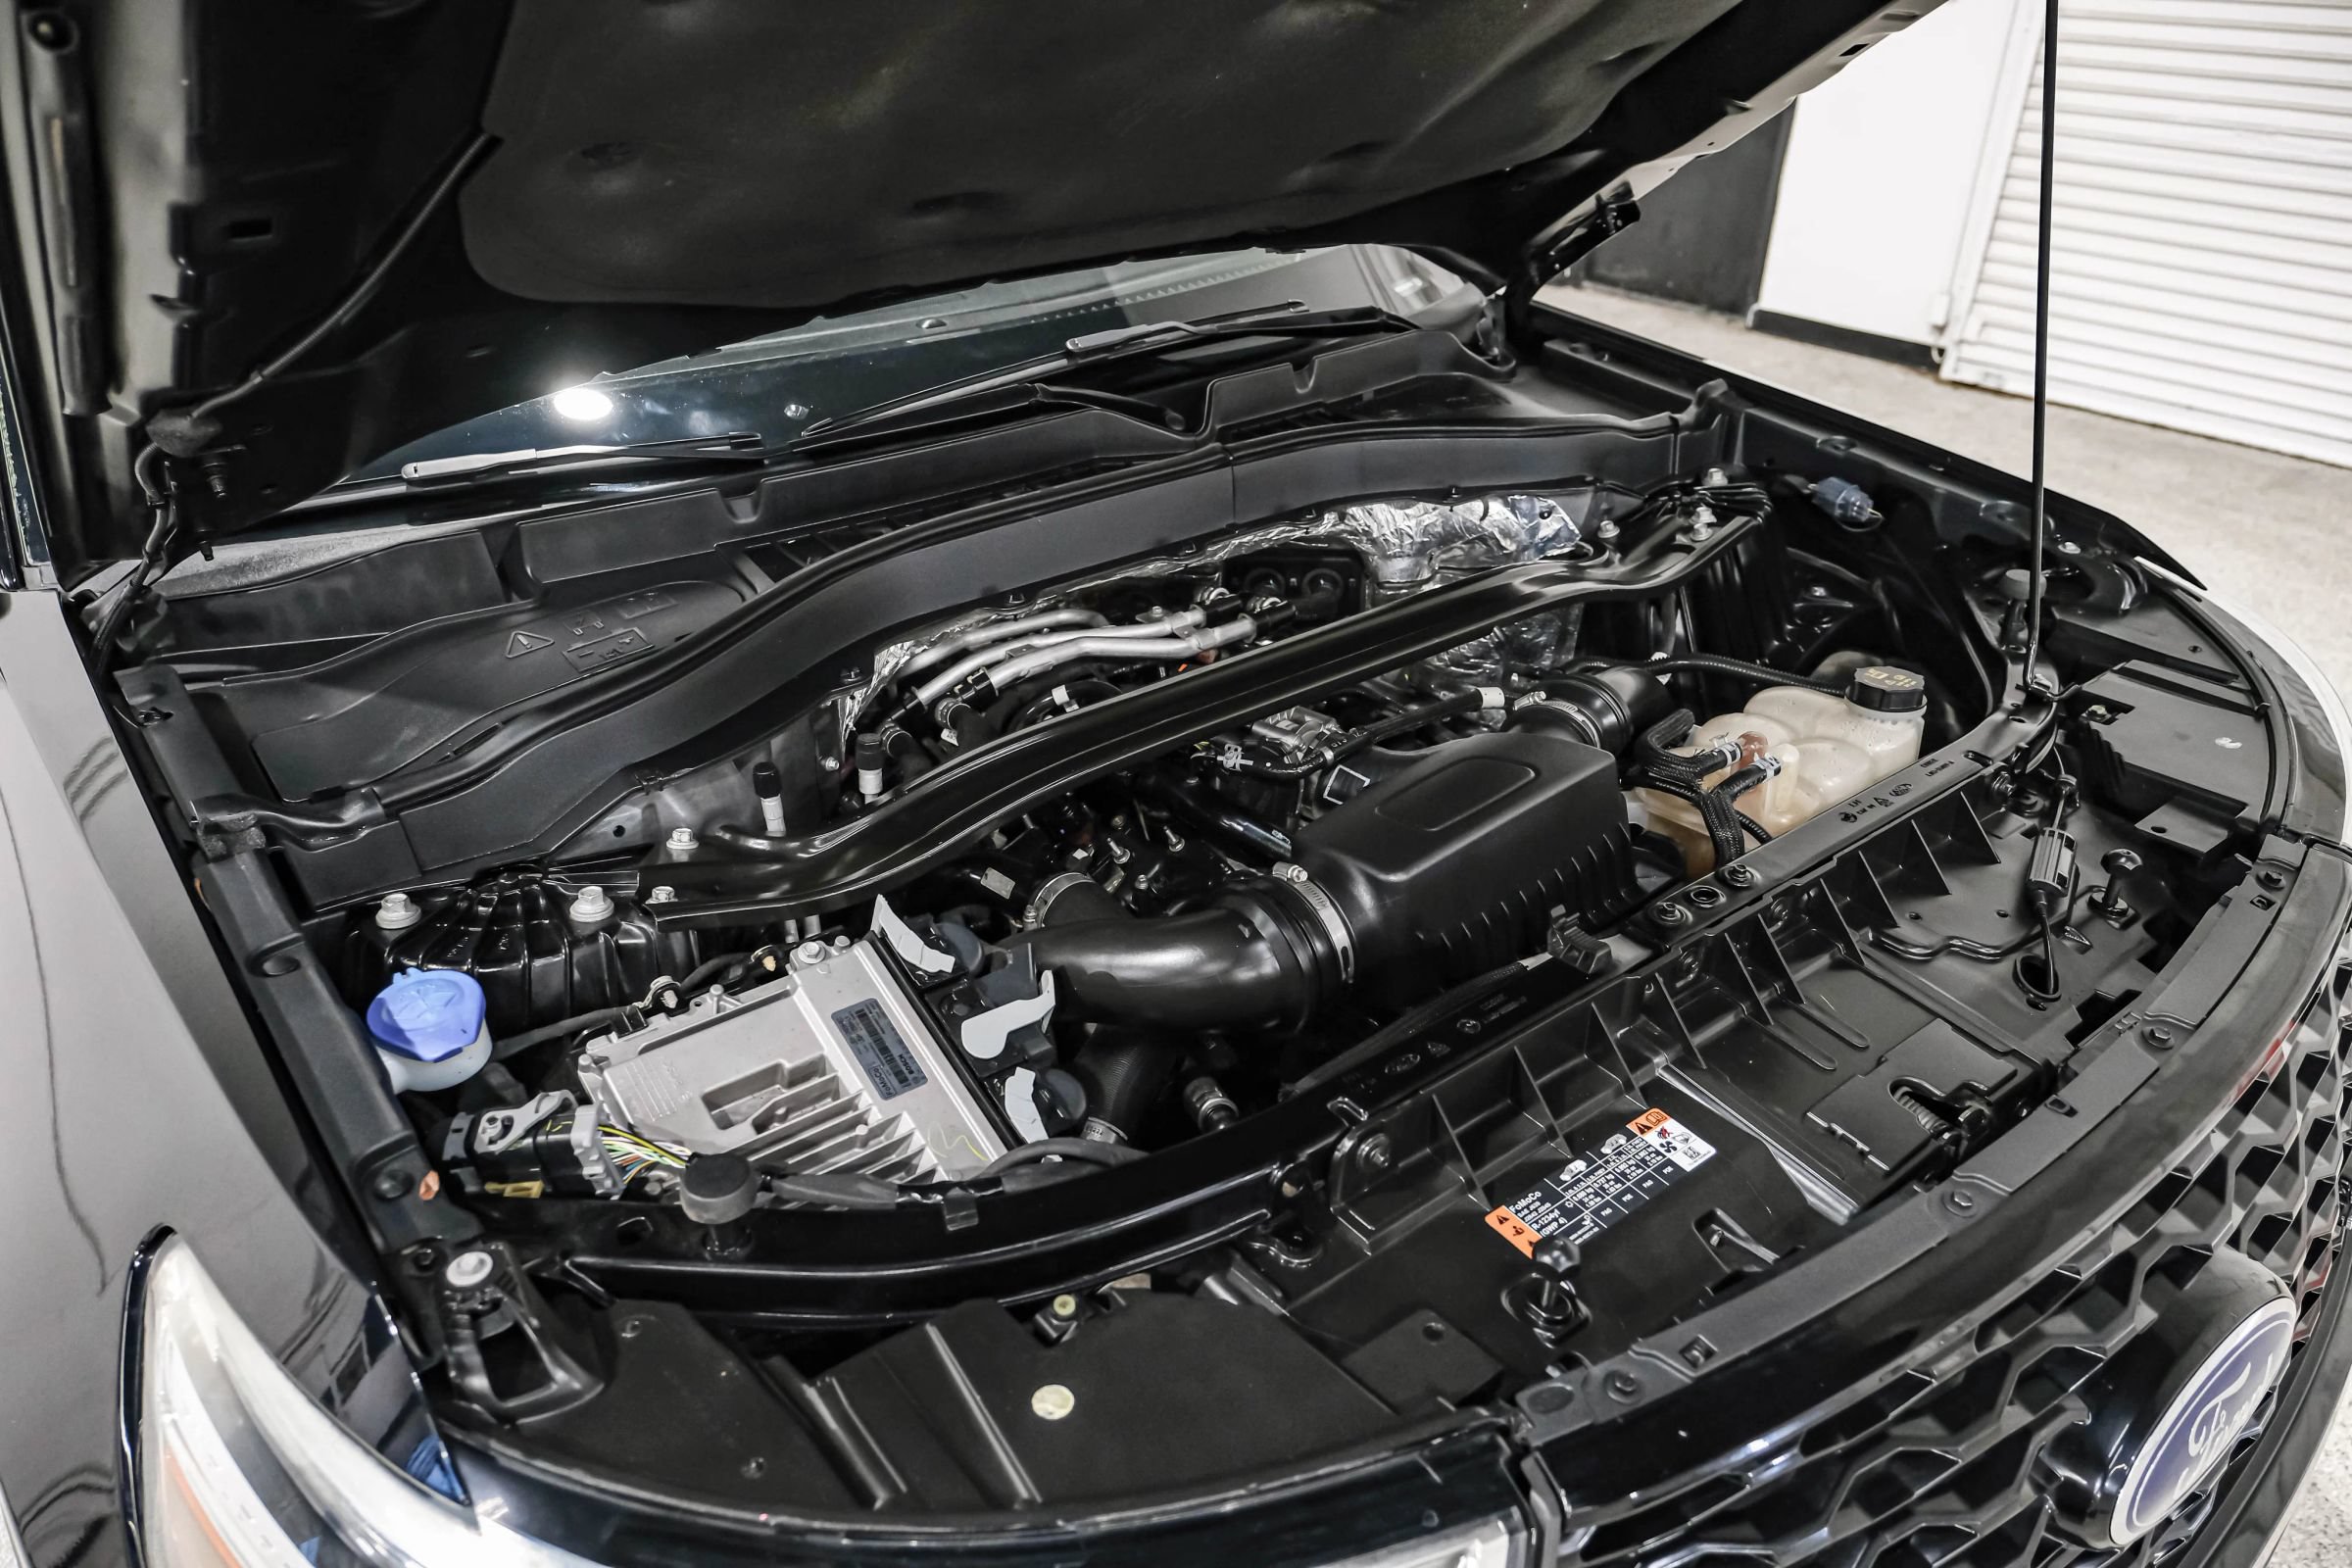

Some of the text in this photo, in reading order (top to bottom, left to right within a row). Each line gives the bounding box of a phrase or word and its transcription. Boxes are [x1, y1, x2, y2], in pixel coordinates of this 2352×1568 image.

[898, 1053, 914, 1075] BOSCH
[1509, 1191, 1542, 1213] FoMoCo
[1531, 1208, 1561, 1231] R-1234yf
[1540, 1221, 1559, 1237] (GWP
